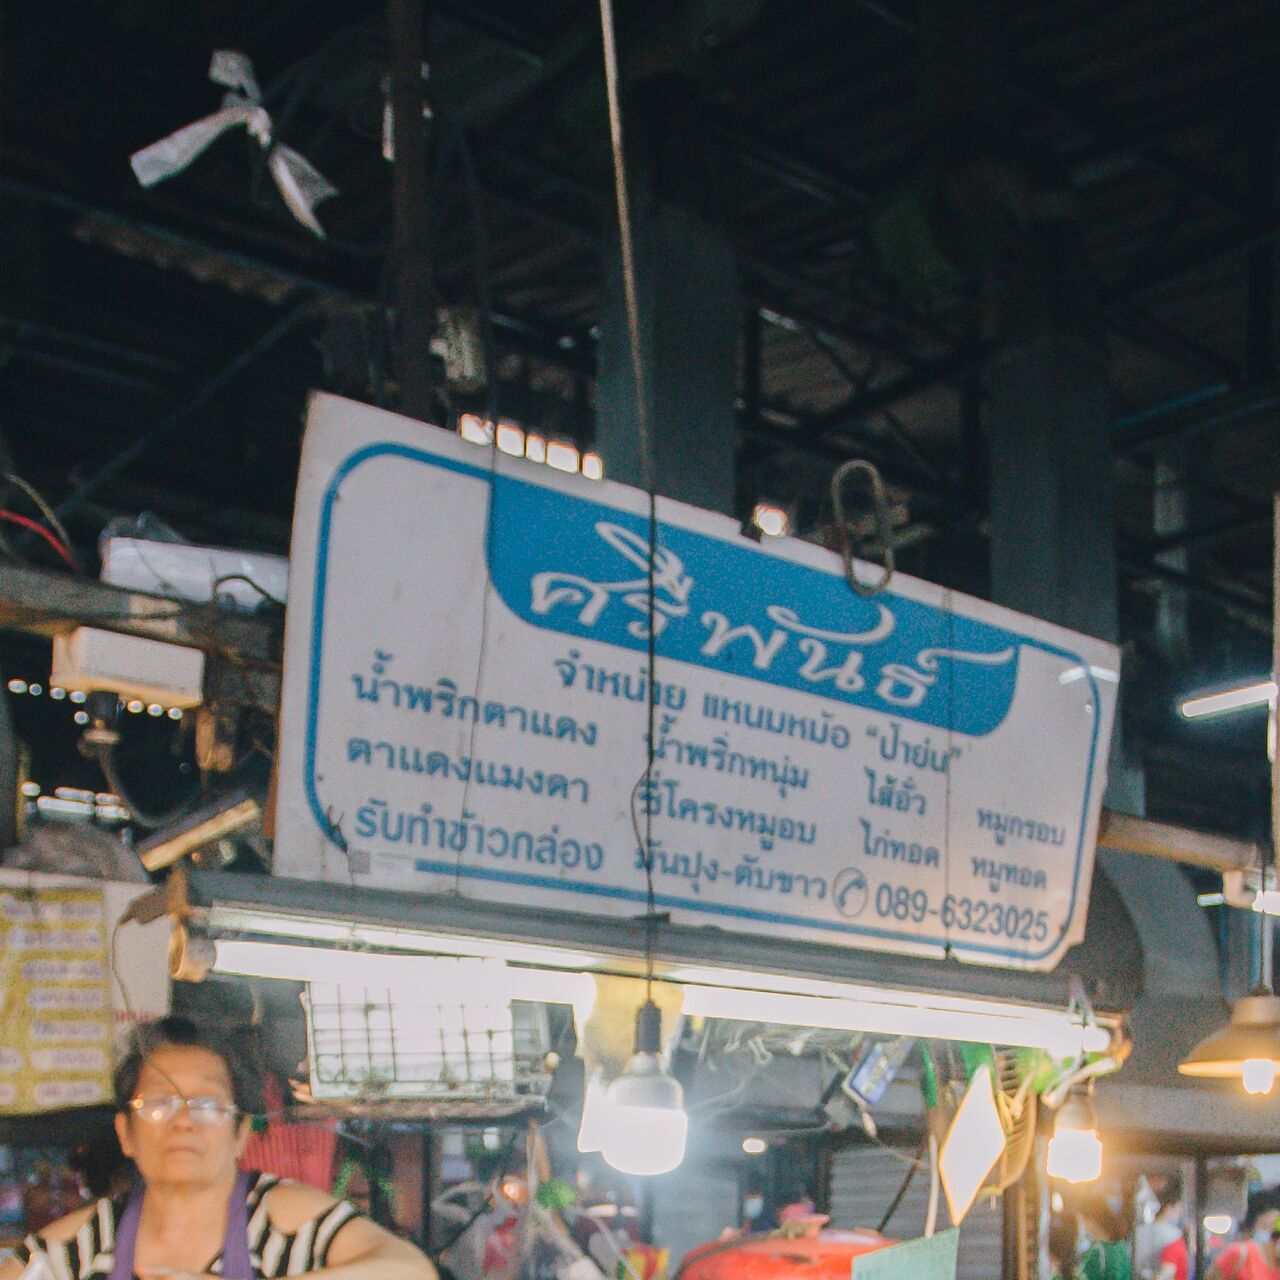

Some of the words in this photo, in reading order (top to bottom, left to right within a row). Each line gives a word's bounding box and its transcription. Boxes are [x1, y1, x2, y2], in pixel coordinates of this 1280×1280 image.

[531, 521, 1015, 708] ศรีพันธ์
[352, 649, 598, 746] น้ำพริกตาแดง
[643, 713, 810, 797] น้ำพริกหนุ่ม
[864, 766, 927, 816] ไส้อั่ว
[977, 808, 1066, 847] หมูกรอบ
[554, 649, 687, 711] จำหน่าย
[703, 690, 851, 750] แหนมหม้อ
[347, 737, 590, 803] ตาแดงแมงดา
[859, 816, 940, 868] ไก่ทอด
[972, 854, 1048, 893] หมูทอด
[355, 798, 605, 871] รับทำข้าวกล่อง
[876, 881, 1050, 943] 089-6323025
